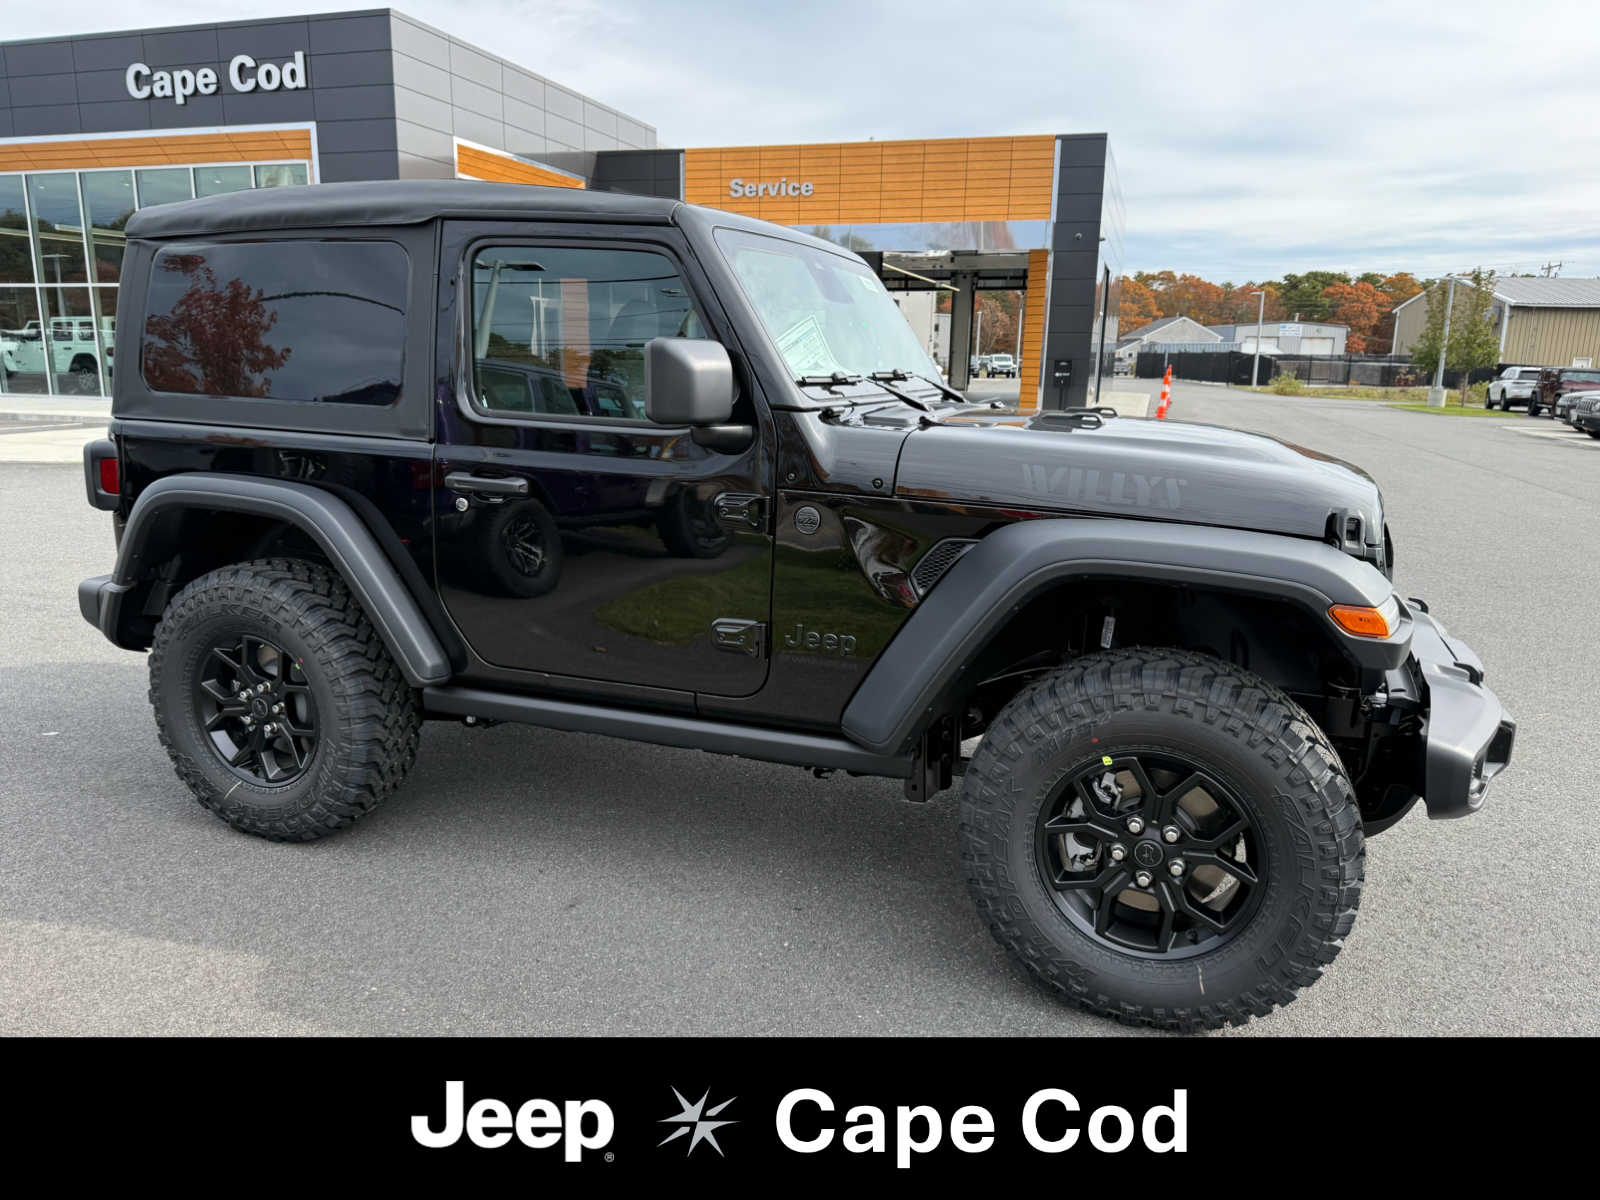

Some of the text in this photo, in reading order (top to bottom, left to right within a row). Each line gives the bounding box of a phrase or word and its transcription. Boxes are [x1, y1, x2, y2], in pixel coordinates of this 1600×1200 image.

[125, 50, 307, 106] Cape Cod
[728, 177, 815, 200] Service
[784, 624, 857, 656] Jeep
